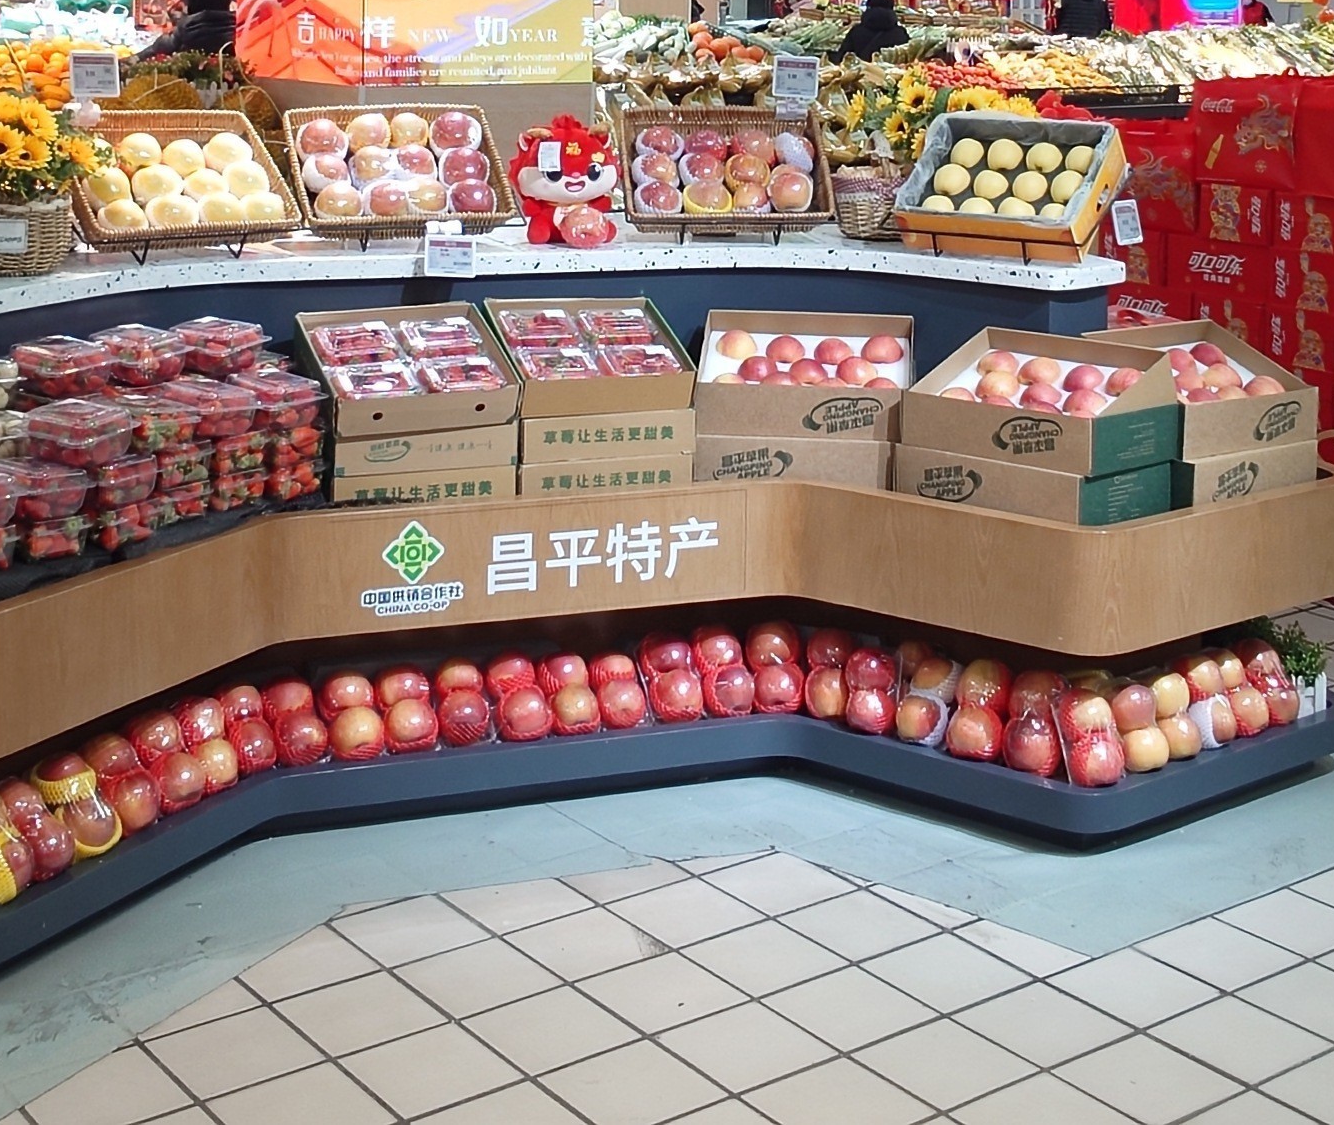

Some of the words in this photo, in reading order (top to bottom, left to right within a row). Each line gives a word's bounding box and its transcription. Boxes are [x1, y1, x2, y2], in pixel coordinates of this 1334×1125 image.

[296, 12, 316, 45] 吉
[362, 16, 396, 49] 祥
[408, 29, 452, 43] NEW
[474, 15, 508, 48] 如
[510, 29, 558, 43] YEAR
[513, 51, 565, 63] decorated
[567, 51, 588, 62] with
[386, 66, 428, 77] families
[518, 65, 558, 79] jubilant
[1188, 251, 1246, 276] 可口可乐
[542, 424, 675, 446] 草莓让生活更甜美
[716, 459, 773, 477] CHANGPING
[541, 468, 673, 492] 草莓让生活更甜美
[920, 478, 966, 492] CHANGPING
[935, 486, 964, 498] APPLE
[487, 516, 720, 596] 昌平特产
[363, 582, 464, 608] 中国供销合作社
[376, 602, 410, 615] CHINA
[412, 599, 449, 613] CO-OP
